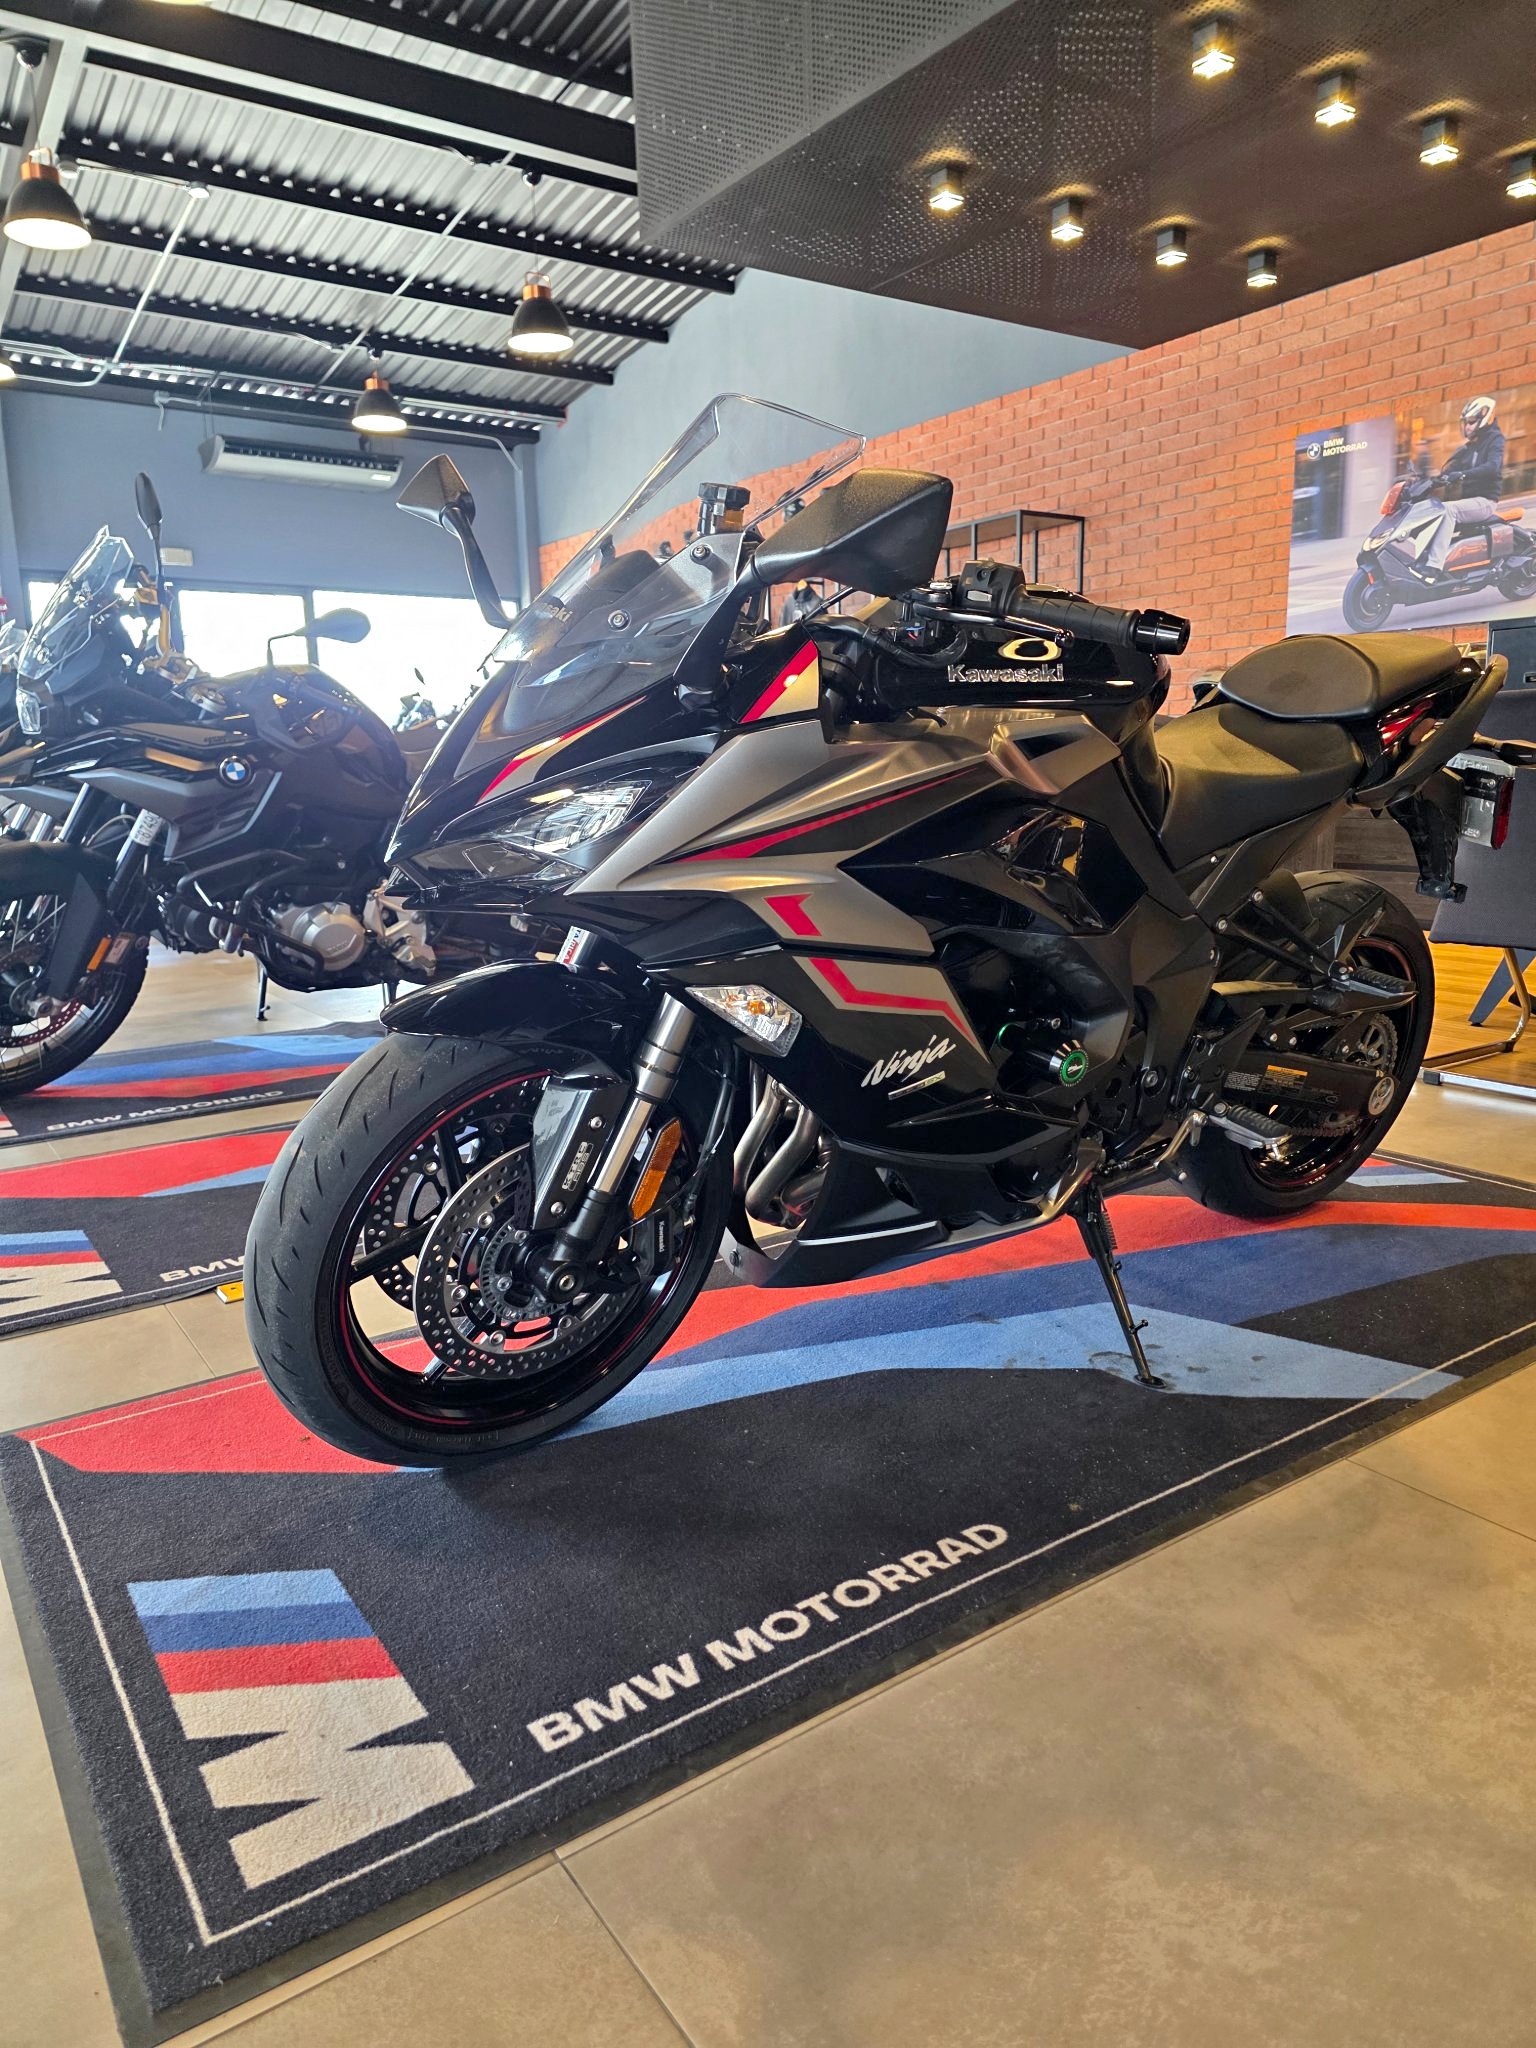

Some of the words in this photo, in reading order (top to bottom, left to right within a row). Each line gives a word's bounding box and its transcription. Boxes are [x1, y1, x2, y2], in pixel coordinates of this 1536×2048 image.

[1322, 441, 1368, 457] MOTORRAD
[1323, 437, 1344, 448] BMW
[947, 663, 1065, 682] Kawasaki
[860, 1034, 957, 1088] Ninja
[46, 1114, 122, 1131] BMW
[129, 1090, 284, 1118] MOTORRAD
[526, 1653, 701, 1753] BMW
[704, 1523, 1009, 1671] MOTORRAD
